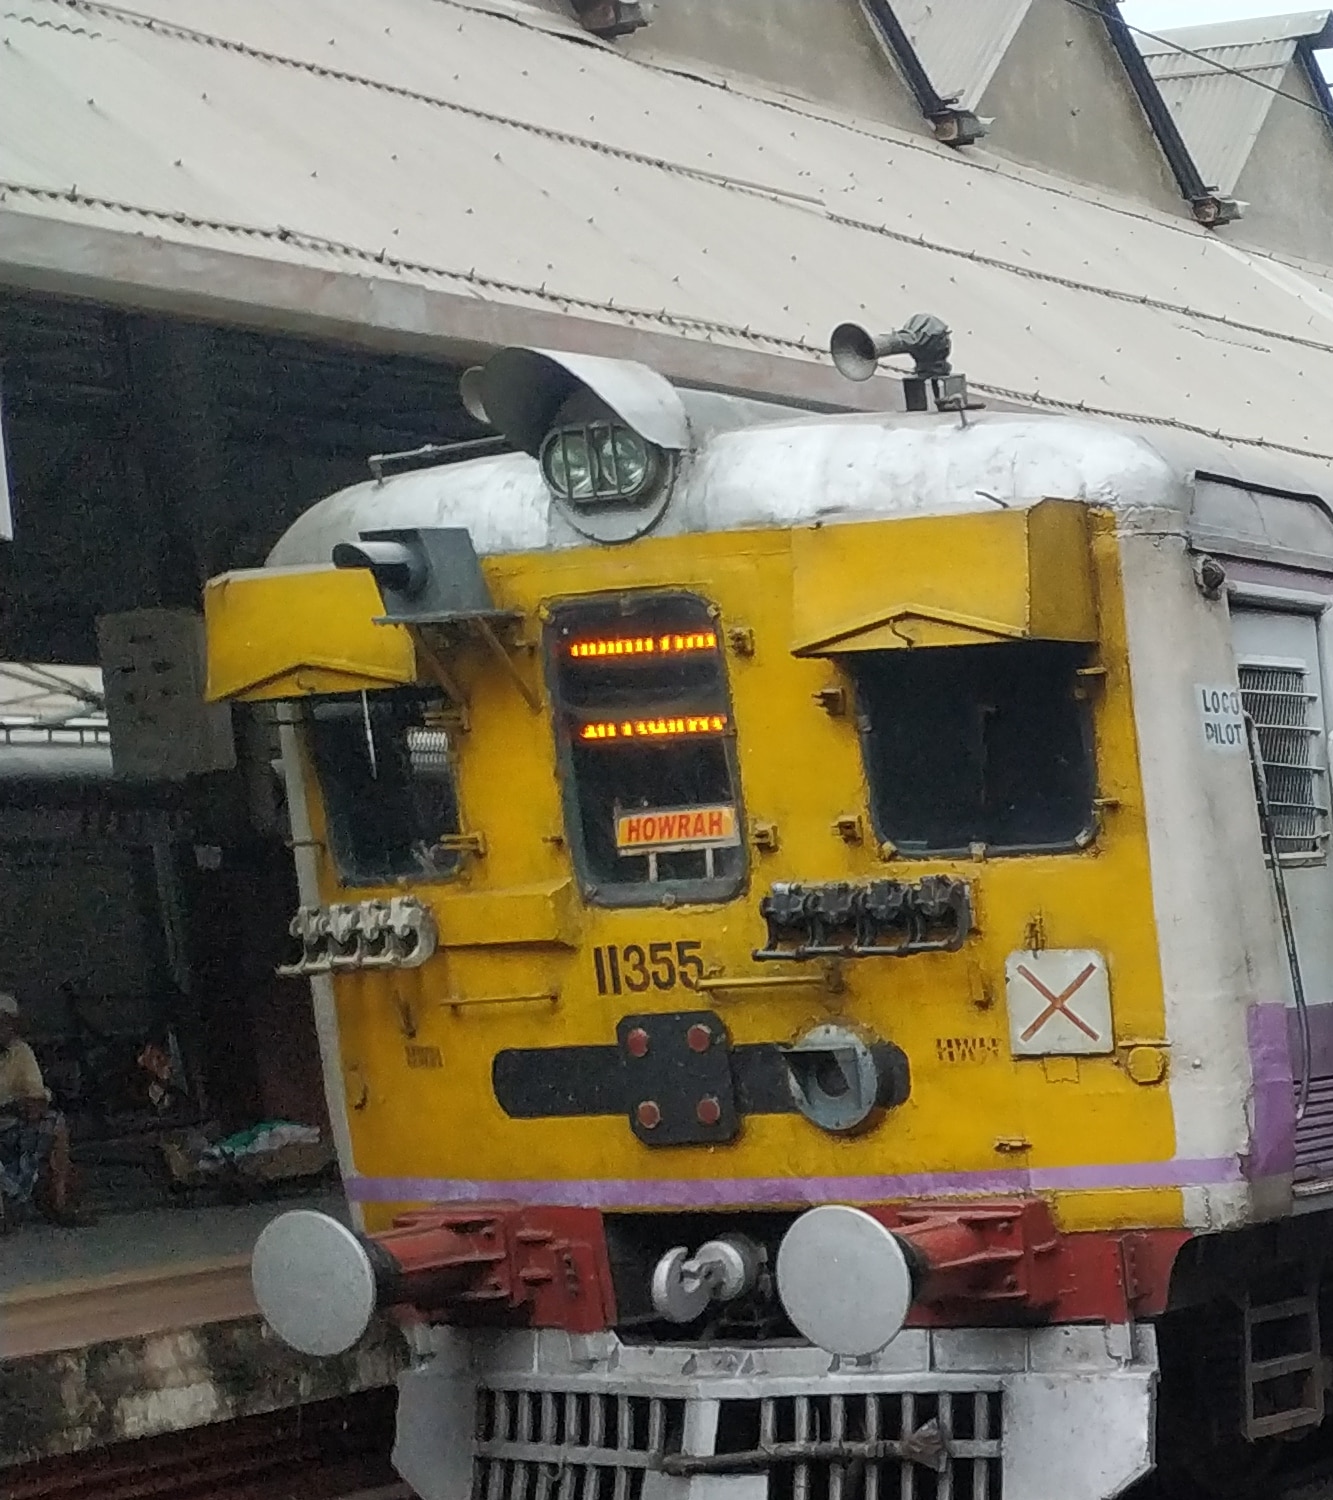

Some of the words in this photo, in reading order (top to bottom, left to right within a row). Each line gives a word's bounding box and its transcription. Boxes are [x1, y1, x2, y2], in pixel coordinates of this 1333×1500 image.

[1201, 689, 1240, 715] LOCO
[1204, 722, 1242, 745] PILOT
[627, 811, 724, 843] HOWRAH
[593, 940, 704, 994] 11355
